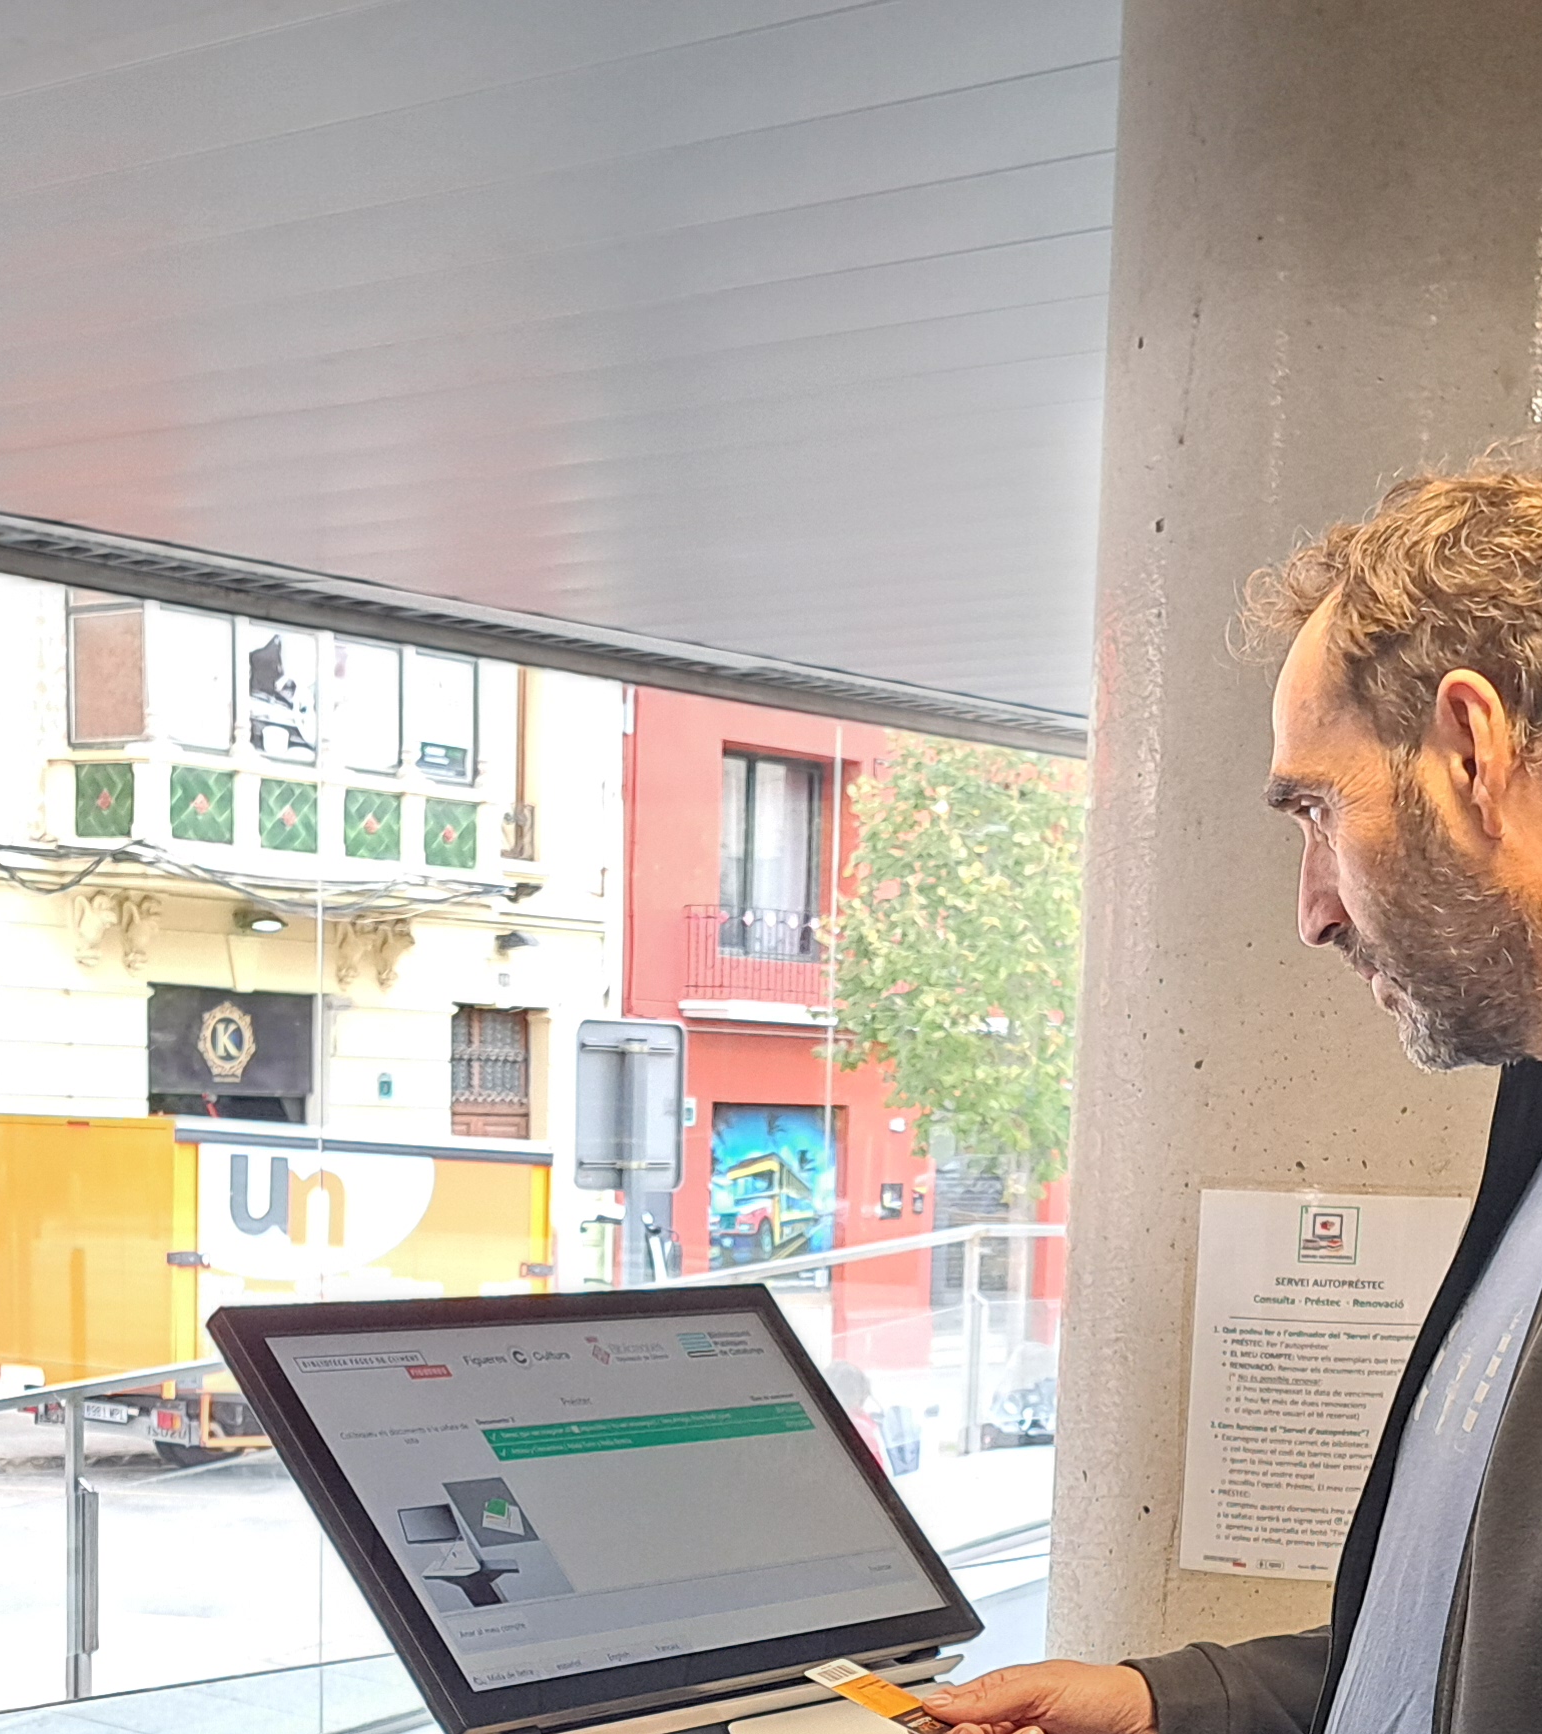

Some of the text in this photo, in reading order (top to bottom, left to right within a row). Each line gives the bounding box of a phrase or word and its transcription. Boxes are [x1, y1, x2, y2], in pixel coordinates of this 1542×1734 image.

[216, 1022, 241, 1057] K
[229, 1153, 346, 1248] un
[1275, 1277, 1384, 1291] SERVEI AUTOPRÉSTEC
[1253, 1294, 1404, 1310] Consulta Préstec Renovació
[461, 1355, 508, 1368] Figueres
[532, 1351, 571, 1363] Cultura
